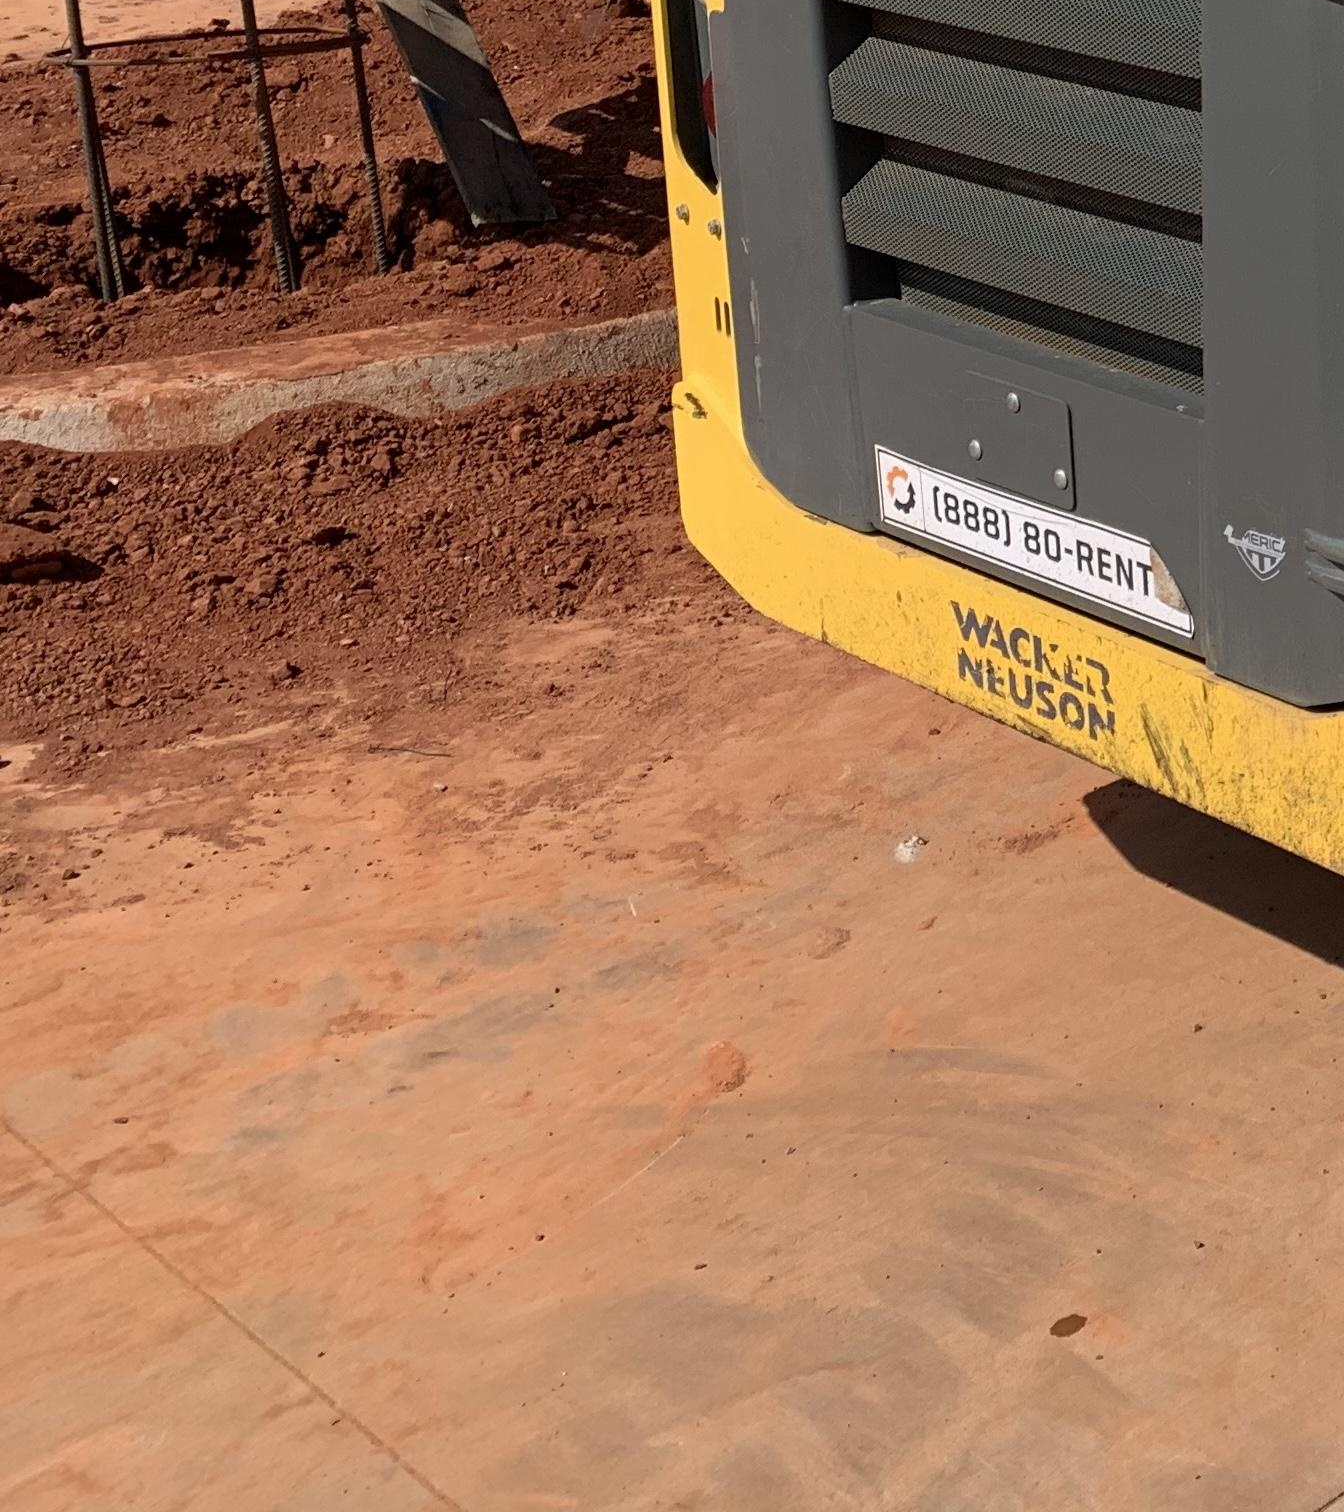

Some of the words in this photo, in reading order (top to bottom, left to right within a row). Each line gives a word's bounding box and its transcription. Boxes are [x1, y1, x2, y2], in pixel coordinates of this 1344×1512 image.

[932, 485, 1011, 547] (888)
[950, 599, 1114, 705] WACKER
[957, 647, 1116, 740] NEUSON
